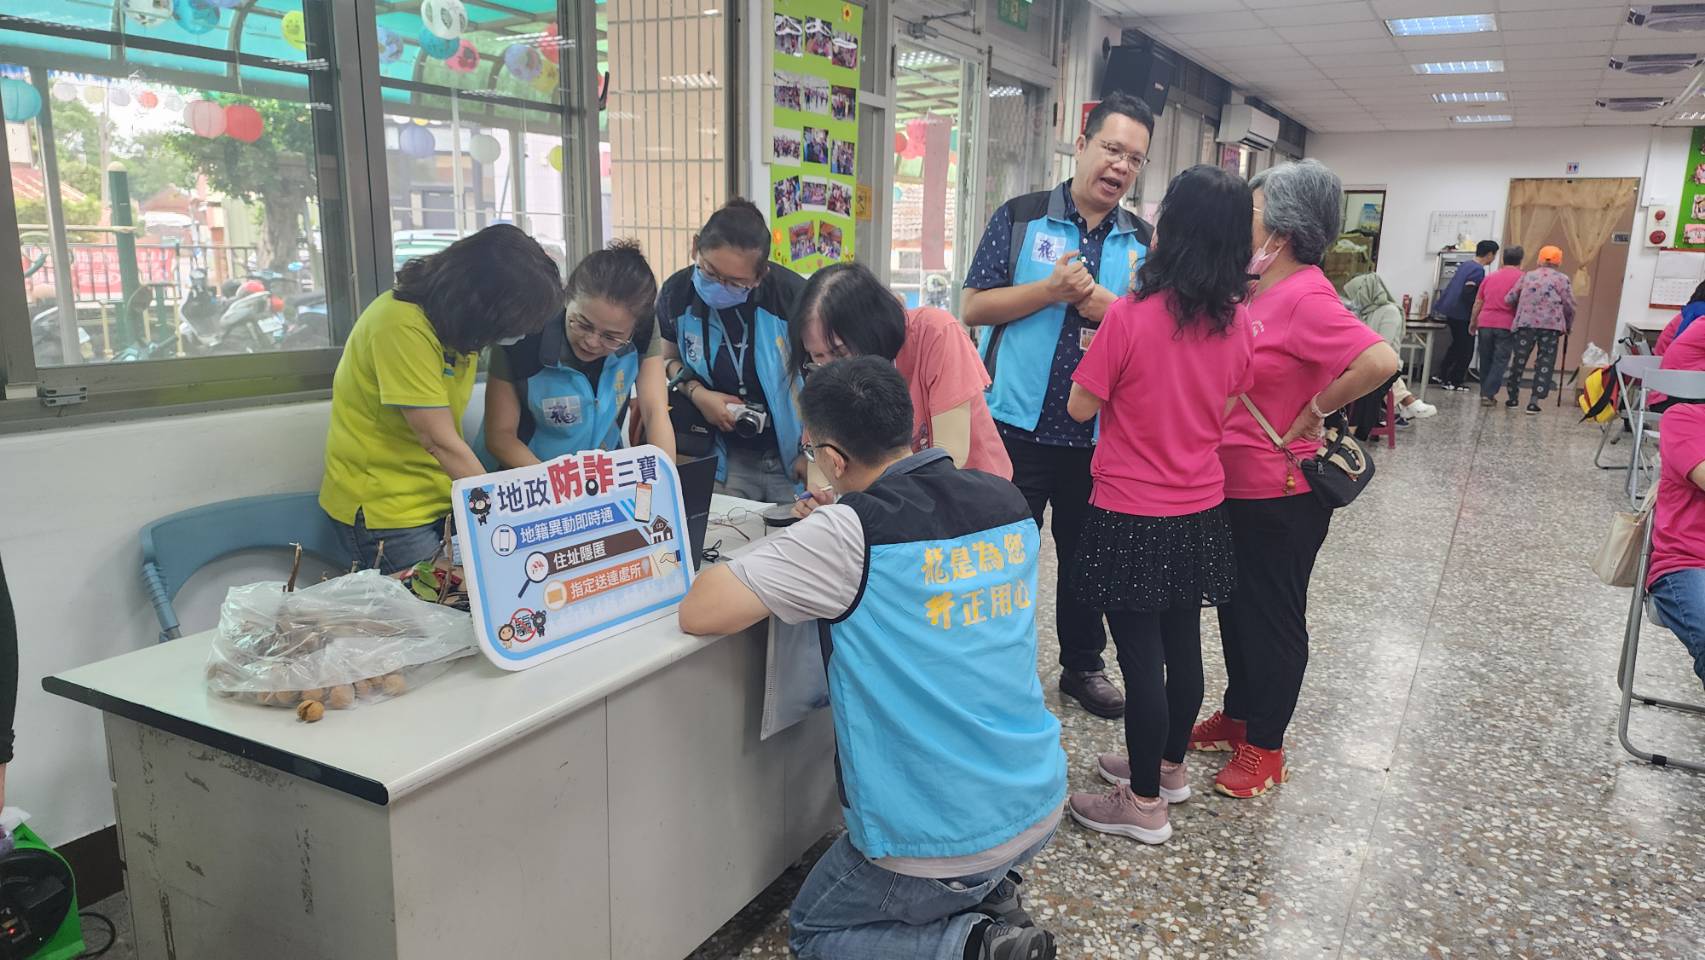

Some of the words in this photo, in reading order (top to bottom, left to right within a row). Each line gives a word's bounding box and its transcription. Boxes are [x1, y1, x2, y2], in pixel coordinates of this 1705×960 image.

[497, 454, 657, 513] 地政防詐三寶
[520, 508, 614, 544] 地籍異動即時通
[553, 541, 606, 570] 住址隱匿
[569, 564, 641, 600] 指定送達處所
